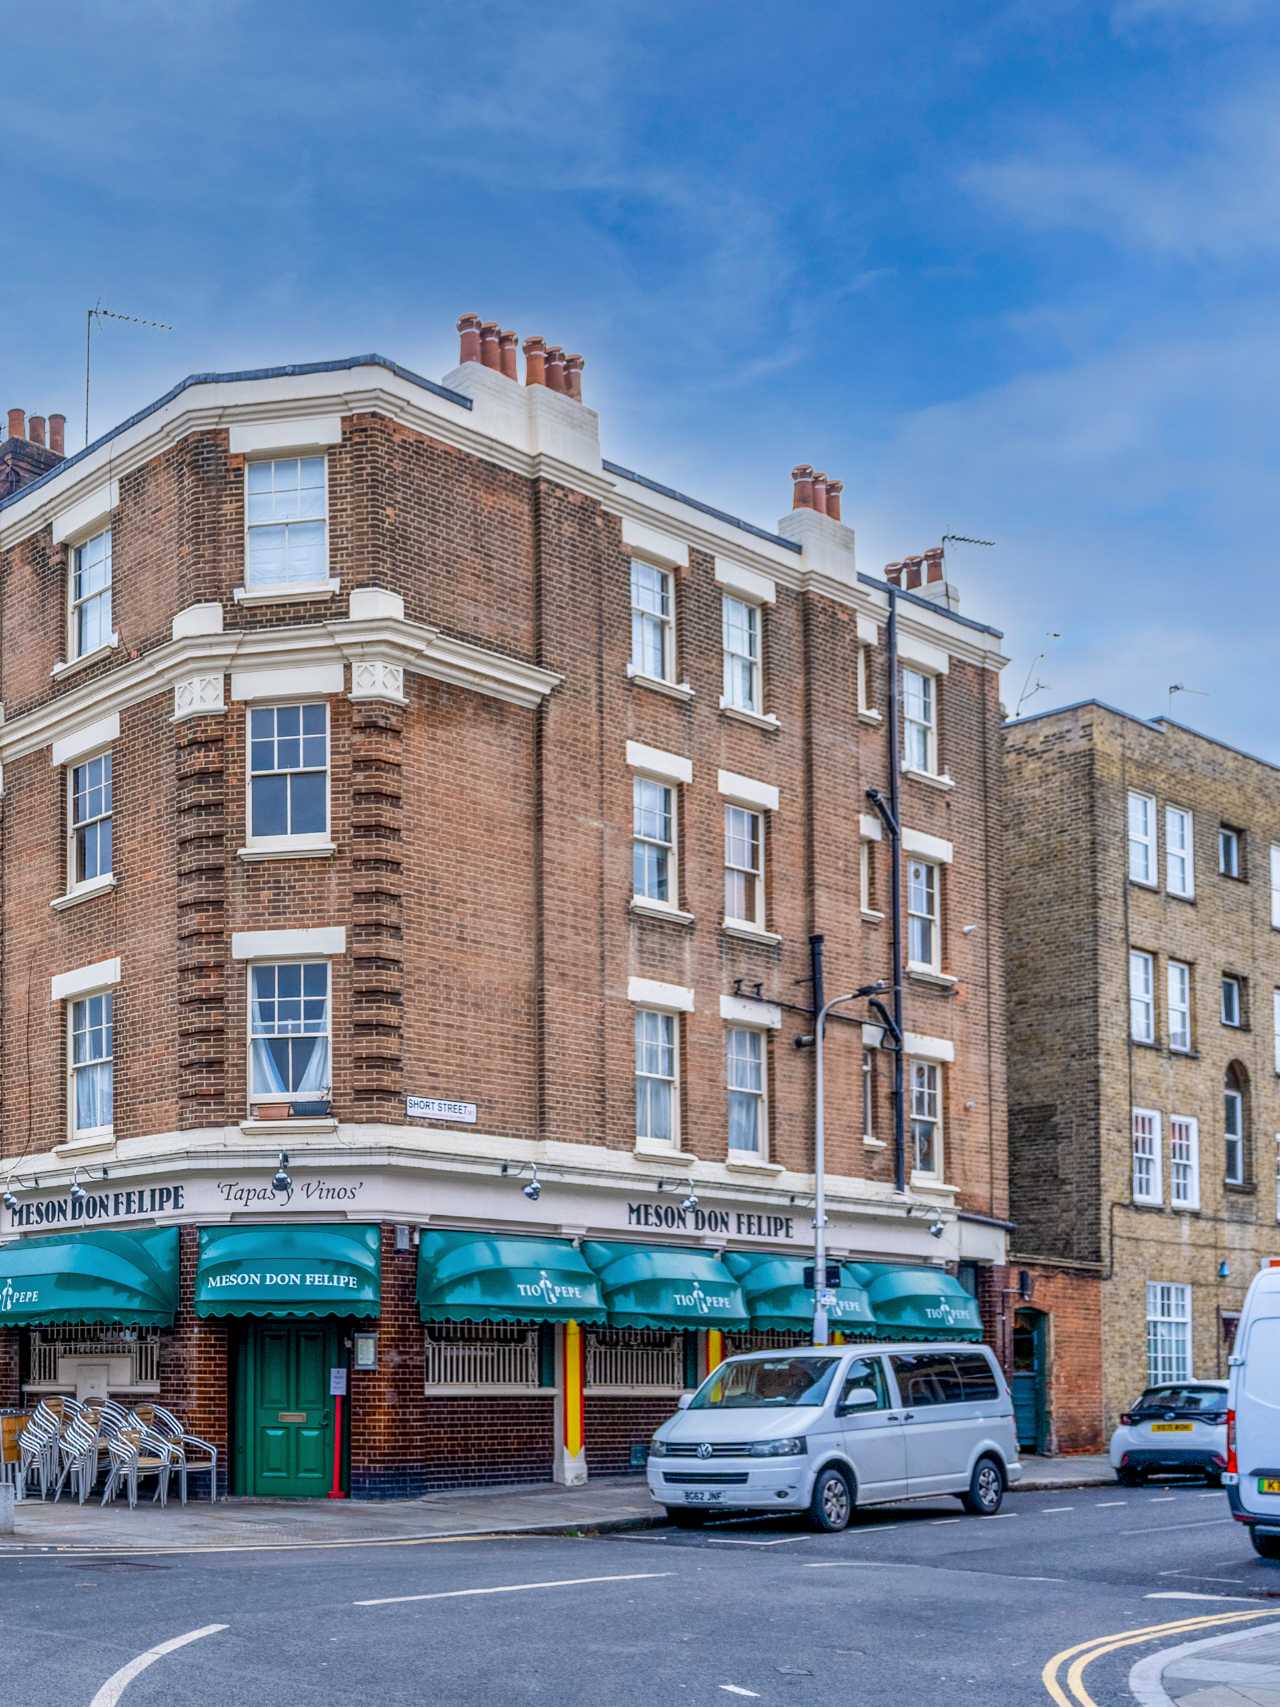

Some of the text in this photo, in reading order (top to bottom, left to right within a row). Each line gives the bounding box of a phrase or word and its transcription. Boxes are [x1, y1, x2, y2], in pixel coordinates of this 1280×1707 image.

[408, 1098, 436, 1111] SHORT
[437, 1103, 468, 1115] STREET
[280, 1186, 294, 1207] y
[11, 1185, 185, 1227] MESON DON FELIPE
[627, 1202, 794, 1239] MESON DON FELIPE
[208, 1273, 358, 1289] MESON DON FELIPE
[13, 1290, 39, 1303] PEPE
[517, 1284, 582, 1298] TIO PEPE
[673, 1294, 732, 1309] TIO PEPE
[838, 1300, 863, 1312] PEPE
[925, 1308, 971, 1321] TIO PEPE
